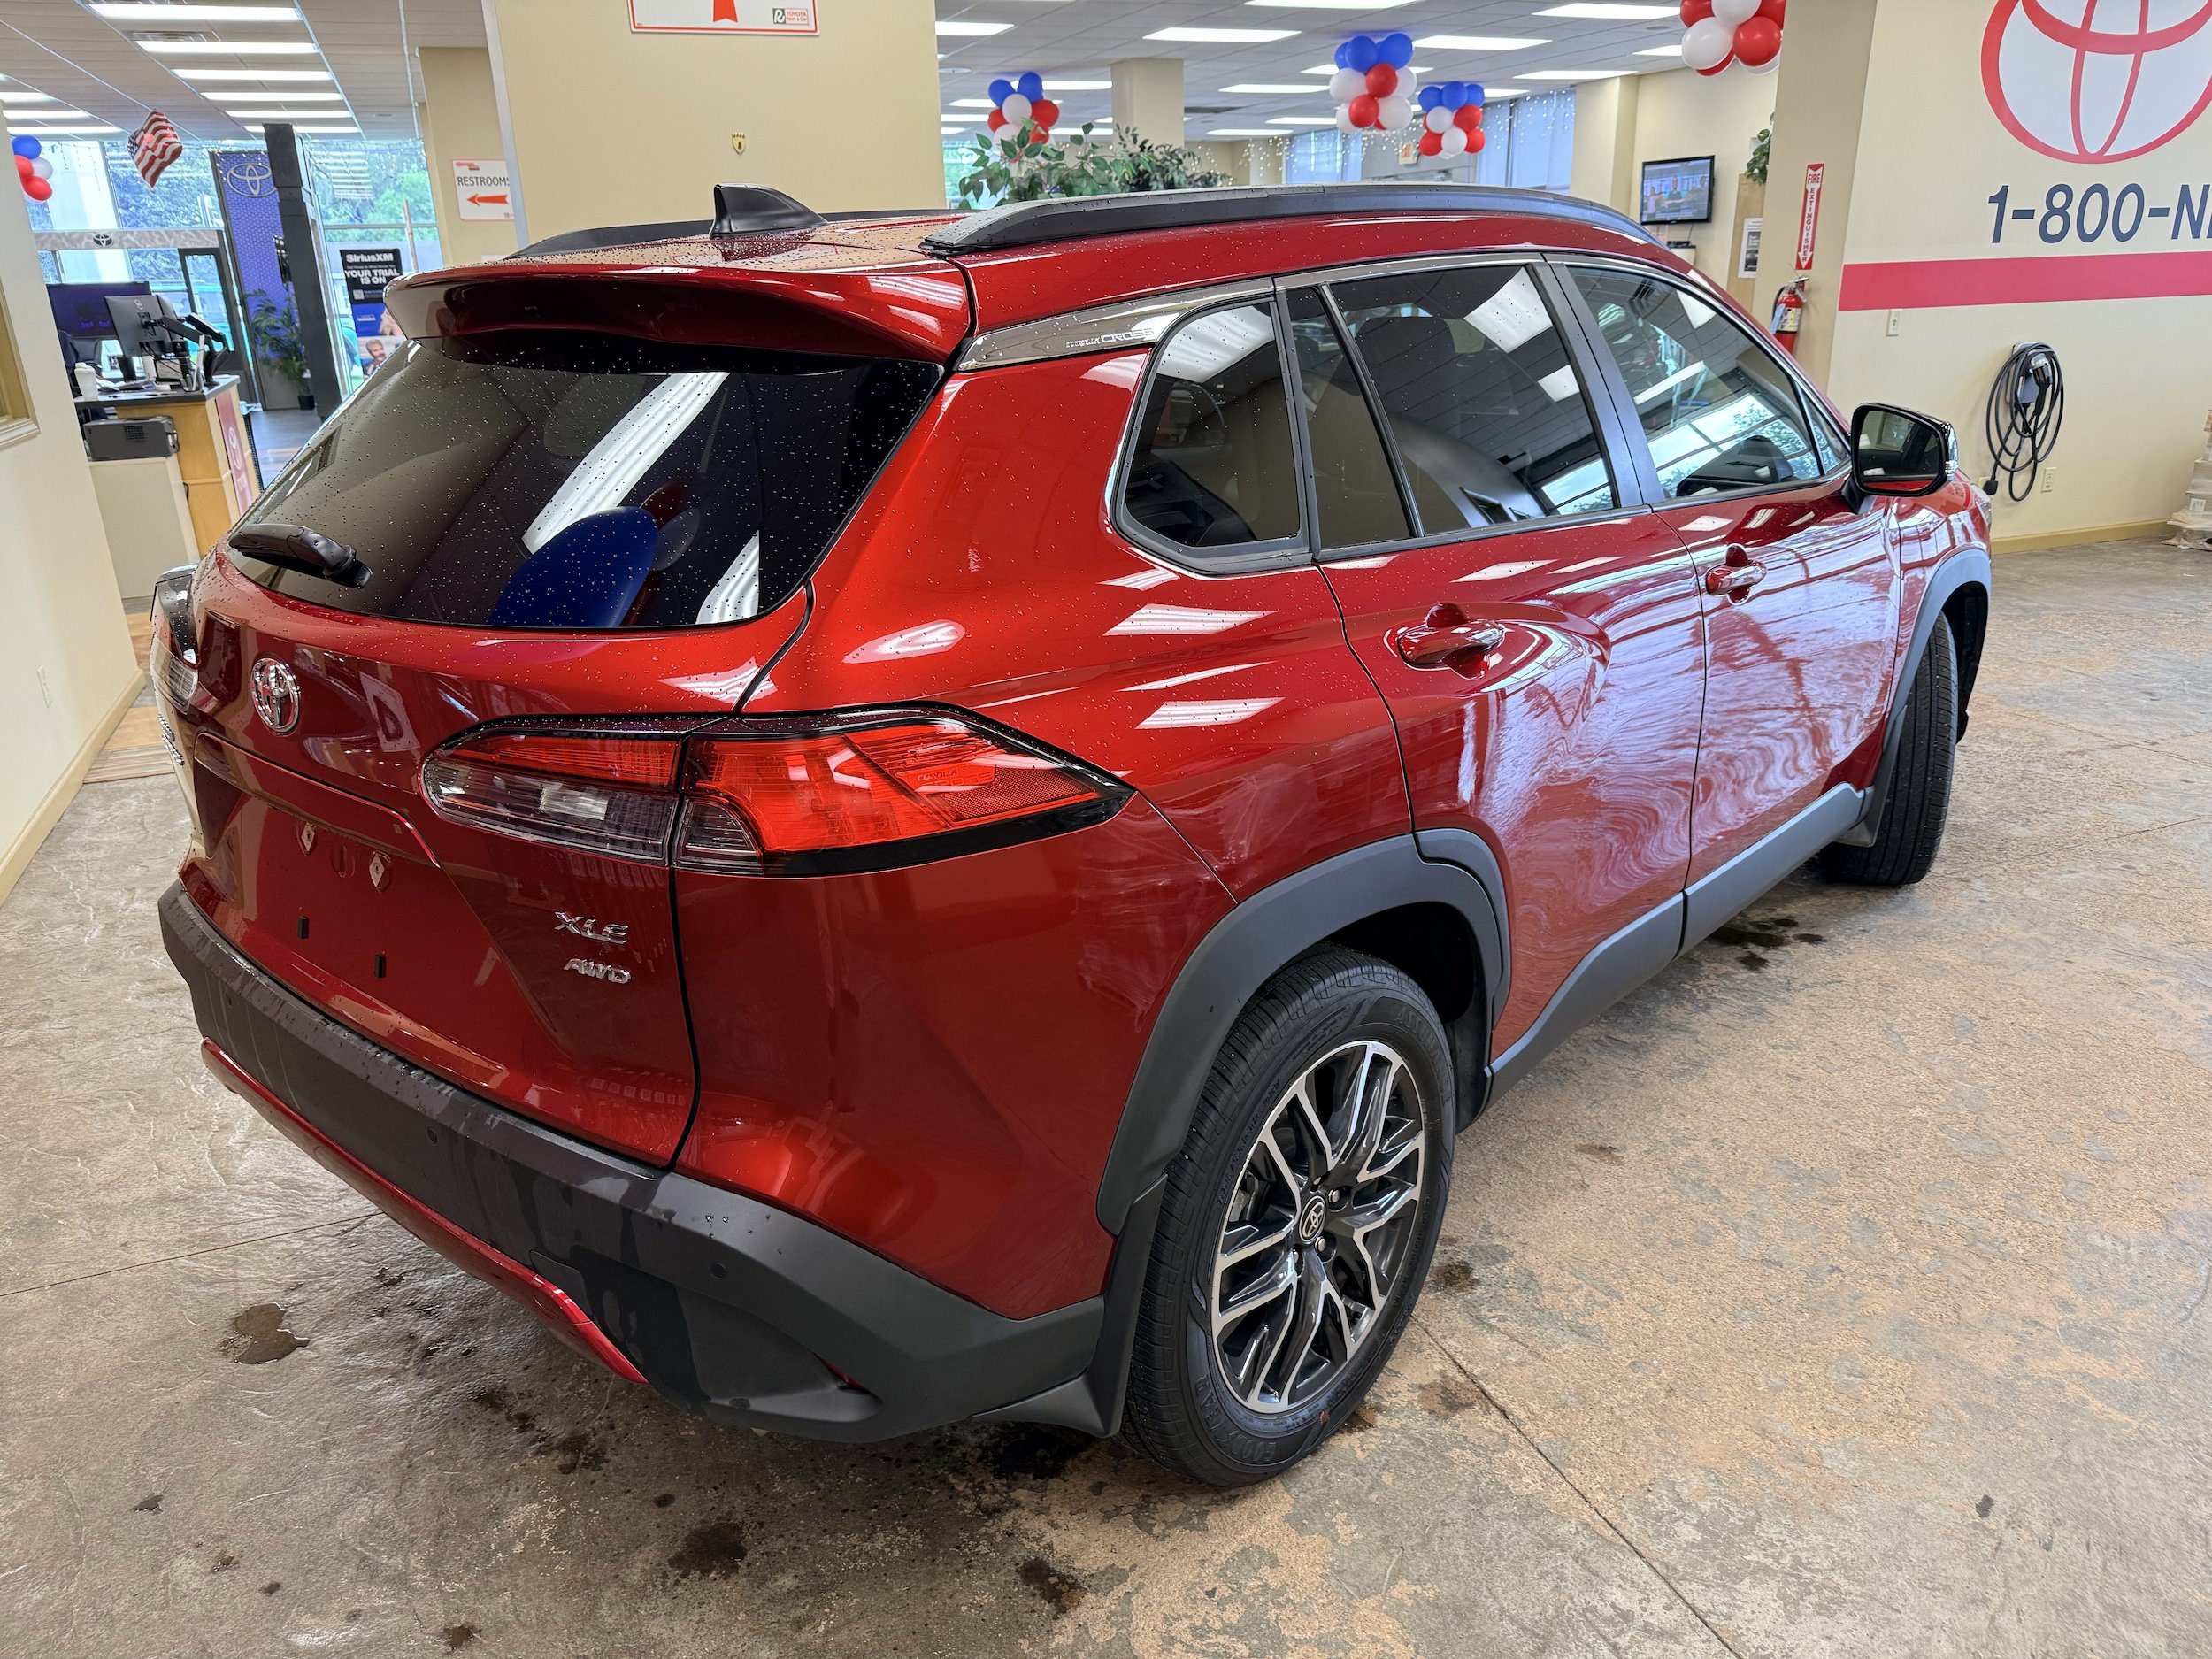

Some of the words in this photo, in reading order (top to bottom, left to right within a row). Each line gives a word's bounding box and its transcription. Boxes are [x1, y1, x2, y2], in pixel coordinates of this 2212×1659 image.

[1808, 173, 1821, 184] FIRE
[1988, 183, 2212, 244] 1-800-N
[1801, 188, 1816, 262] EXTINGUISHER
[346, 253, 394, 263] SiriusXM
[345, 269, 372, 279] YOUR
[373, 268, 400, 277] TRIAL
[372, 276, 387, 285] ON
[1101, 328, 1154, 343] CROSS
[918, 770, 957, 781] COROLLA
[554, 911, 629, 945] XLE
[564, 958, 632, 984] AWD
[1194, 1374, 1277, 1462] GOODYEAR
